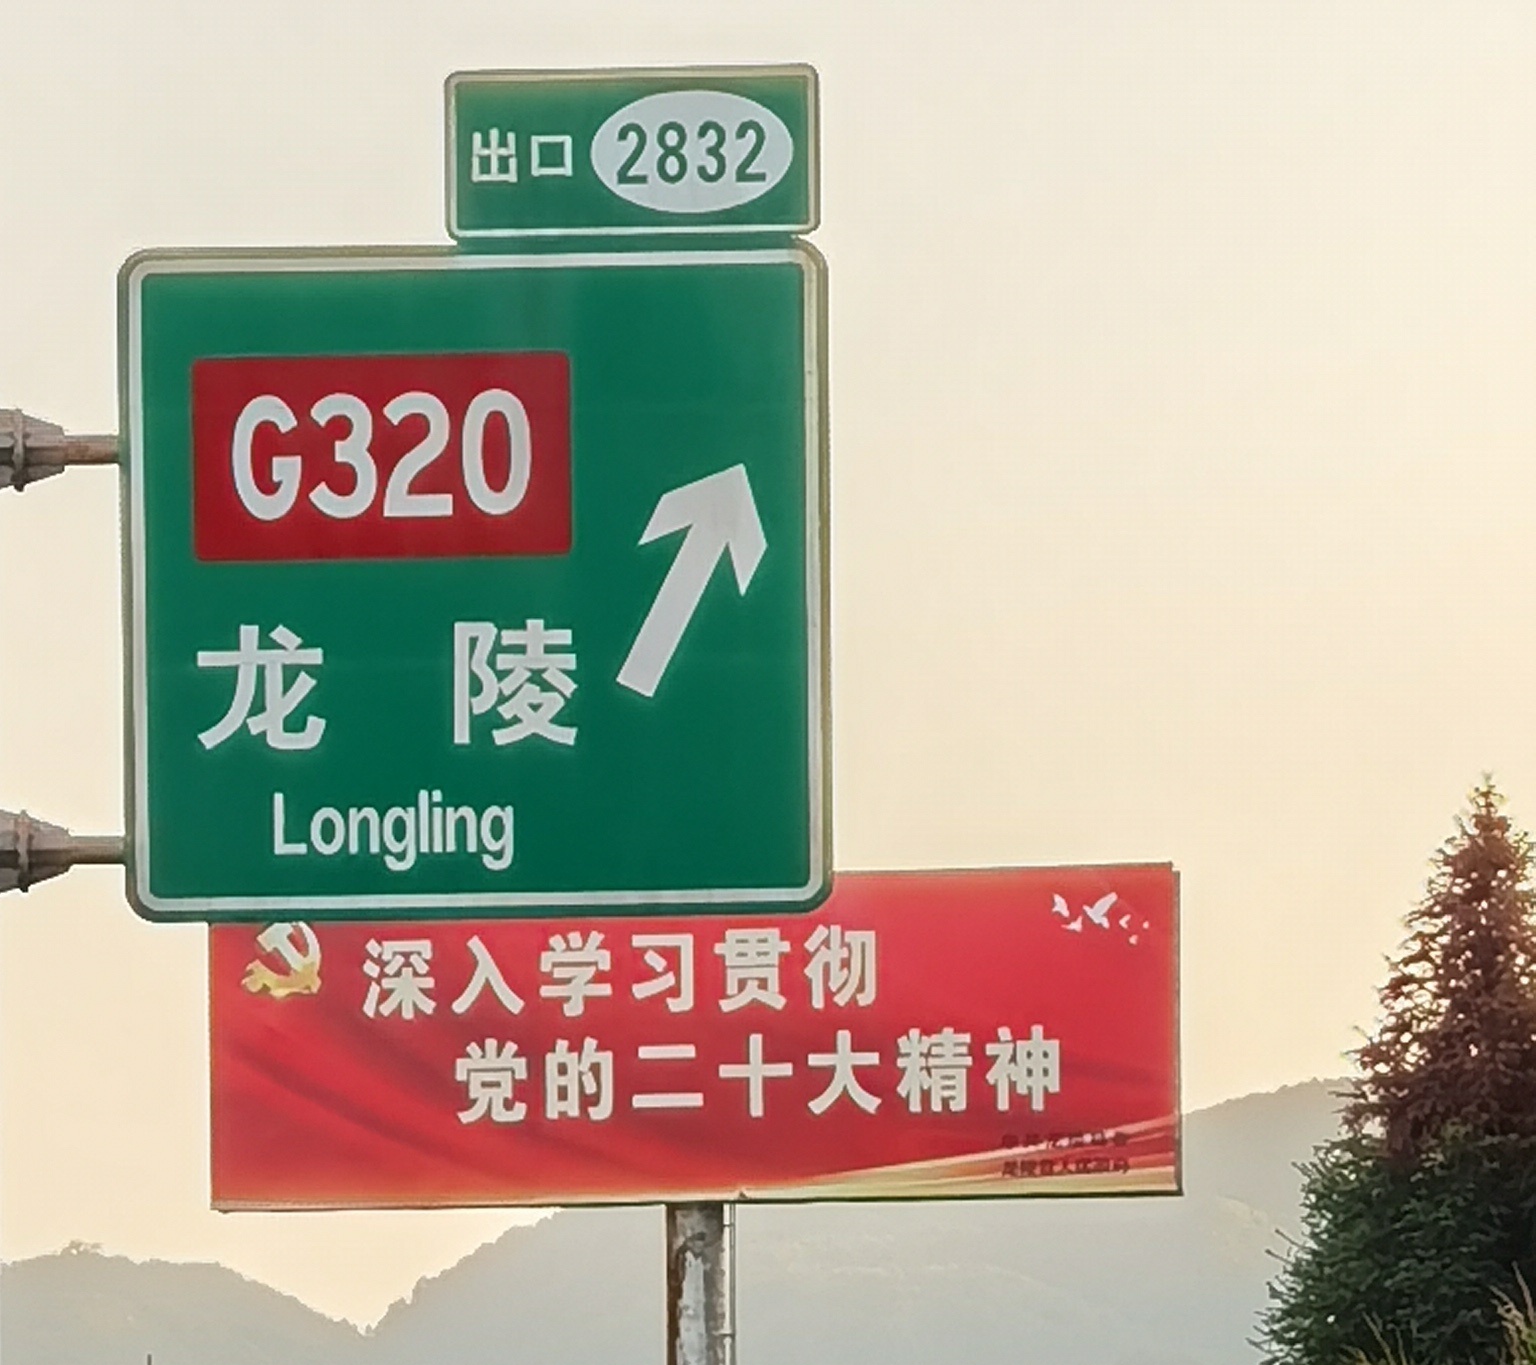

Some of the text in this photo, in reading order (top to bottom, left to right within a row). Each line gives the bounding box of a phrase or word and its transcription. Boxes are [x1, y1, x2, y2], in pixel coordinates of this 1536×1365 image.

[471, 119, 768, 186] 出口 2832
[231, 388, 532, 521] G320
[197, 618, 579, 752] 龙陵
[273, 789, 515, 871] Longling
[362, 924, 878, 1020] 深入学习贯彻
[455, 1025, 1063, 1125] 党的二十大精神
